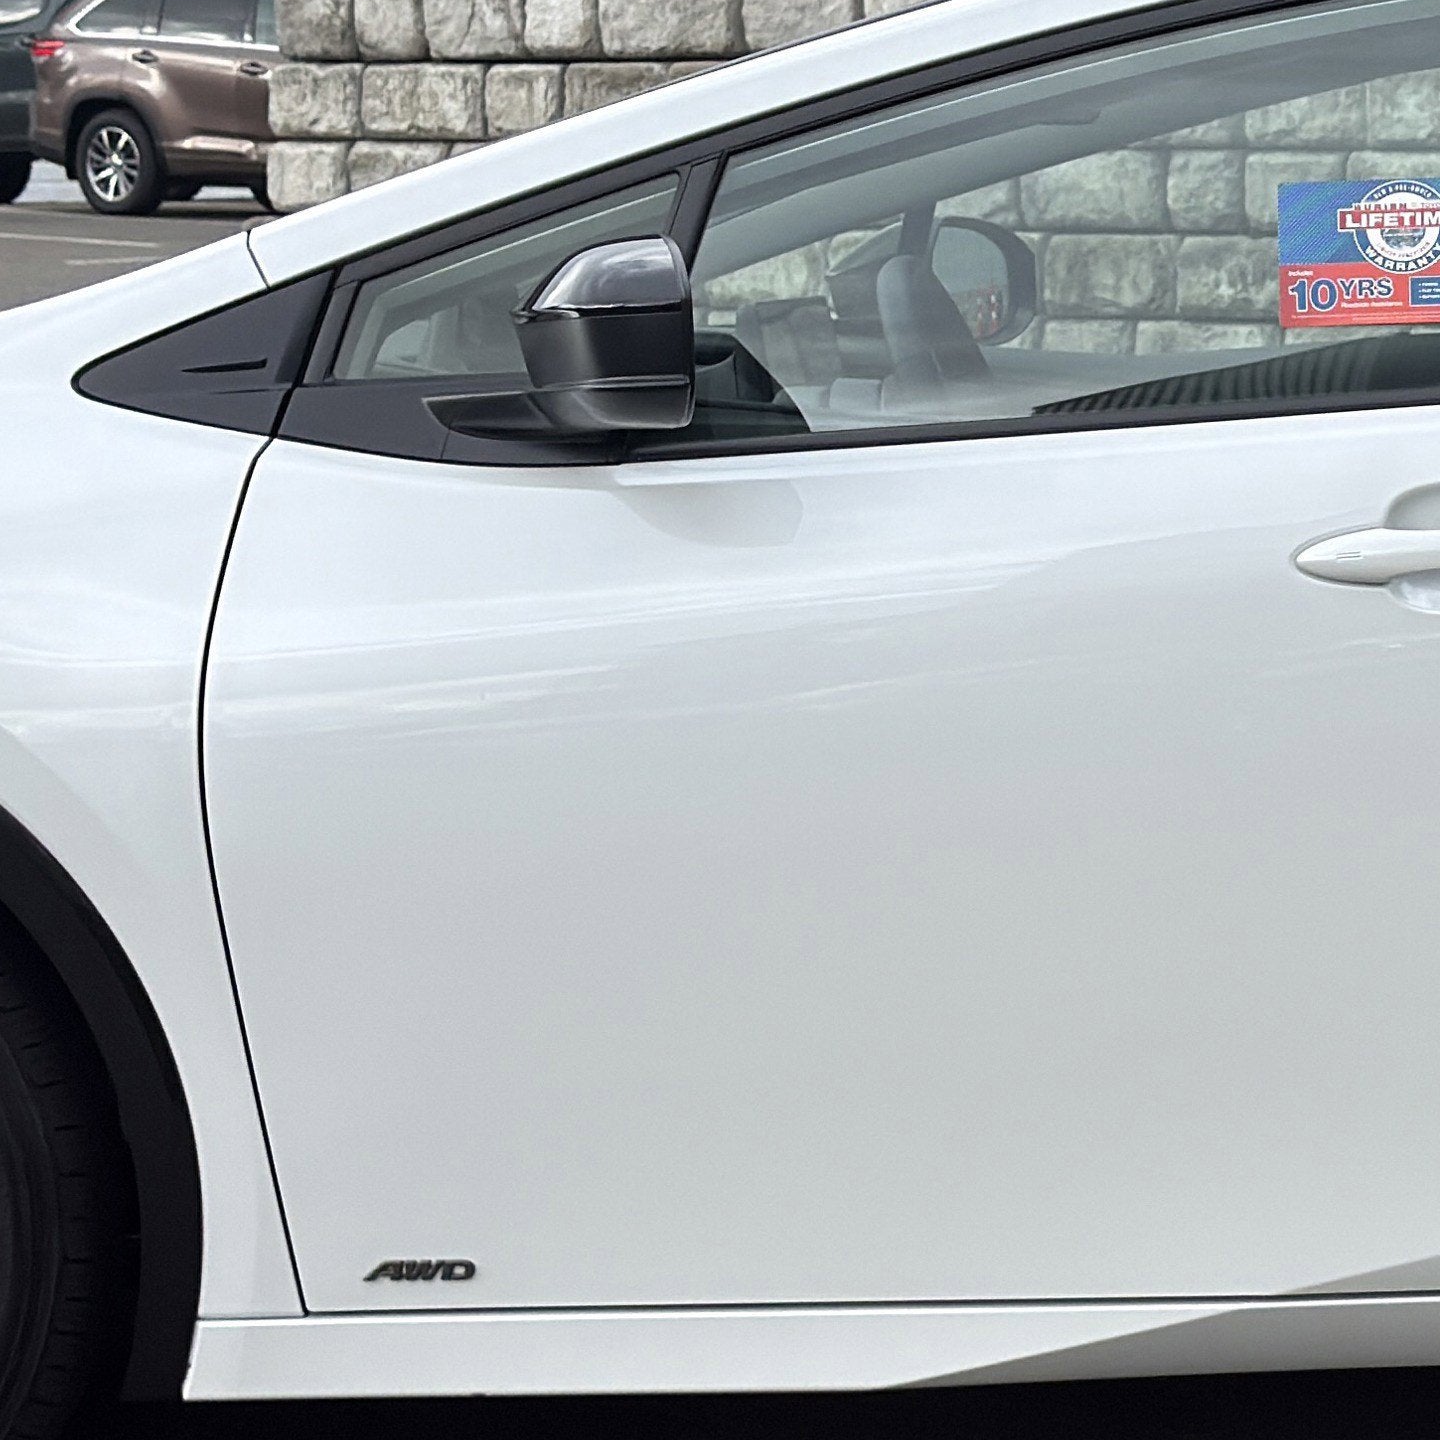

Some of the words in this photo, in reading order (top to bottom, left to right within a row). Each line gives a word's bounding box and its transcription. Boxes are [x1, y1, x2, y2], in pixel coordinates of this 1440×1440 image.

[1288, 278, 1338, 312] 10
[1337, 276, 1394, 299] YRS
[363, 1259, 475, 1281] AWD
